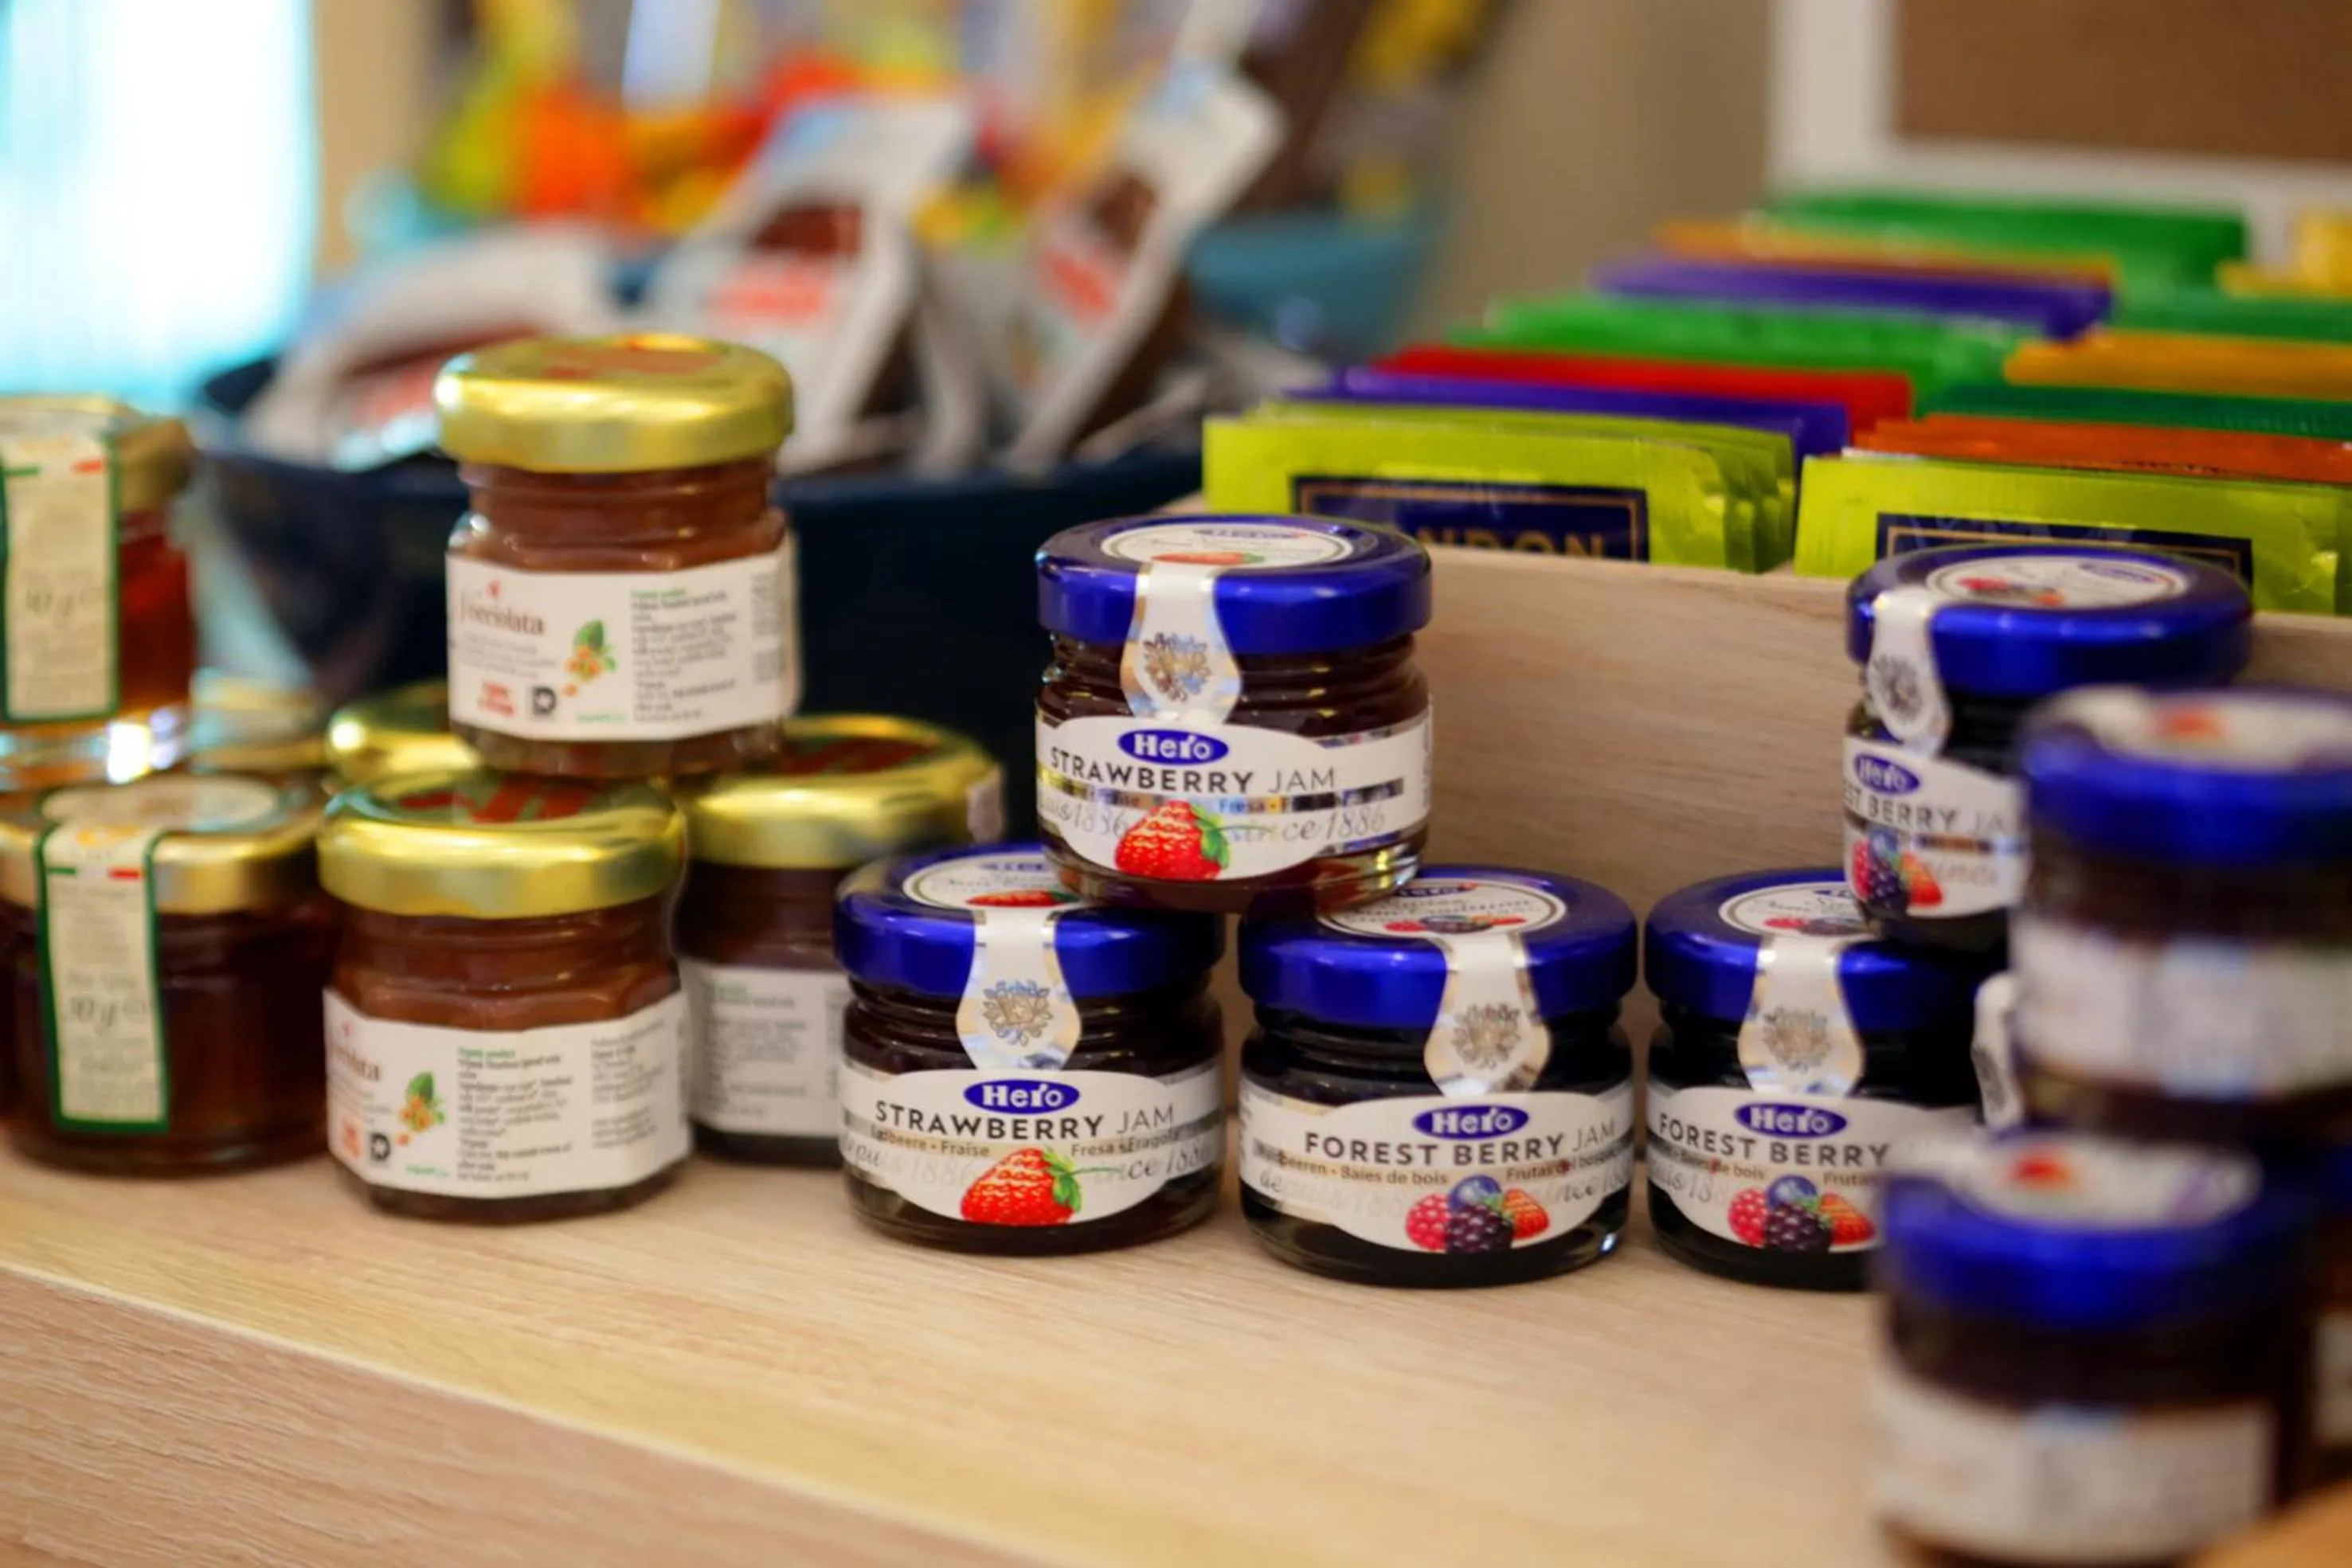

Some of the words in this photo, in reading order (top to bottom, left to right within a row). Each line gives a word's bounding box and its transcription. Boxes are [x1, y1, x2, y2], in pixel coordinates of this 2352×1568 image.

[1133, 733, 1212, 760] Hero
[1051, 745, 1254, 793] STRAWBERRY
[1268, 766, 1335, 794] JAM
[1858, 757, 1907, 791] Hero
[1869, 795, 1957, 831] BERRY
[982, 1083, 1063, 1108] Hero
[875, 1100, 1104, 1140] STRAWBERRY
[1117, 1102, 1174, 1134] JAM
[1431, 1107, 1513, 1133] Hero
[1750, 1106, 1830, 1133] Hero
[941, 1140, 990, 1158] Fraise
[1305, 1131, 1438, 1166] FOREST
[1454, 1132, 1564, 1166] BERRY
[1571, 1118, 1615, 1152] JAM
[1659, 1112, 1755, 1159] FOREST
[1770, 1142, 1891, 1167] BERRY
[1340, 1165, 1382, 1183] Baies
[1387, 1169, 1404, 1185] de
[1411, 1170, 1448, 1186] bois
